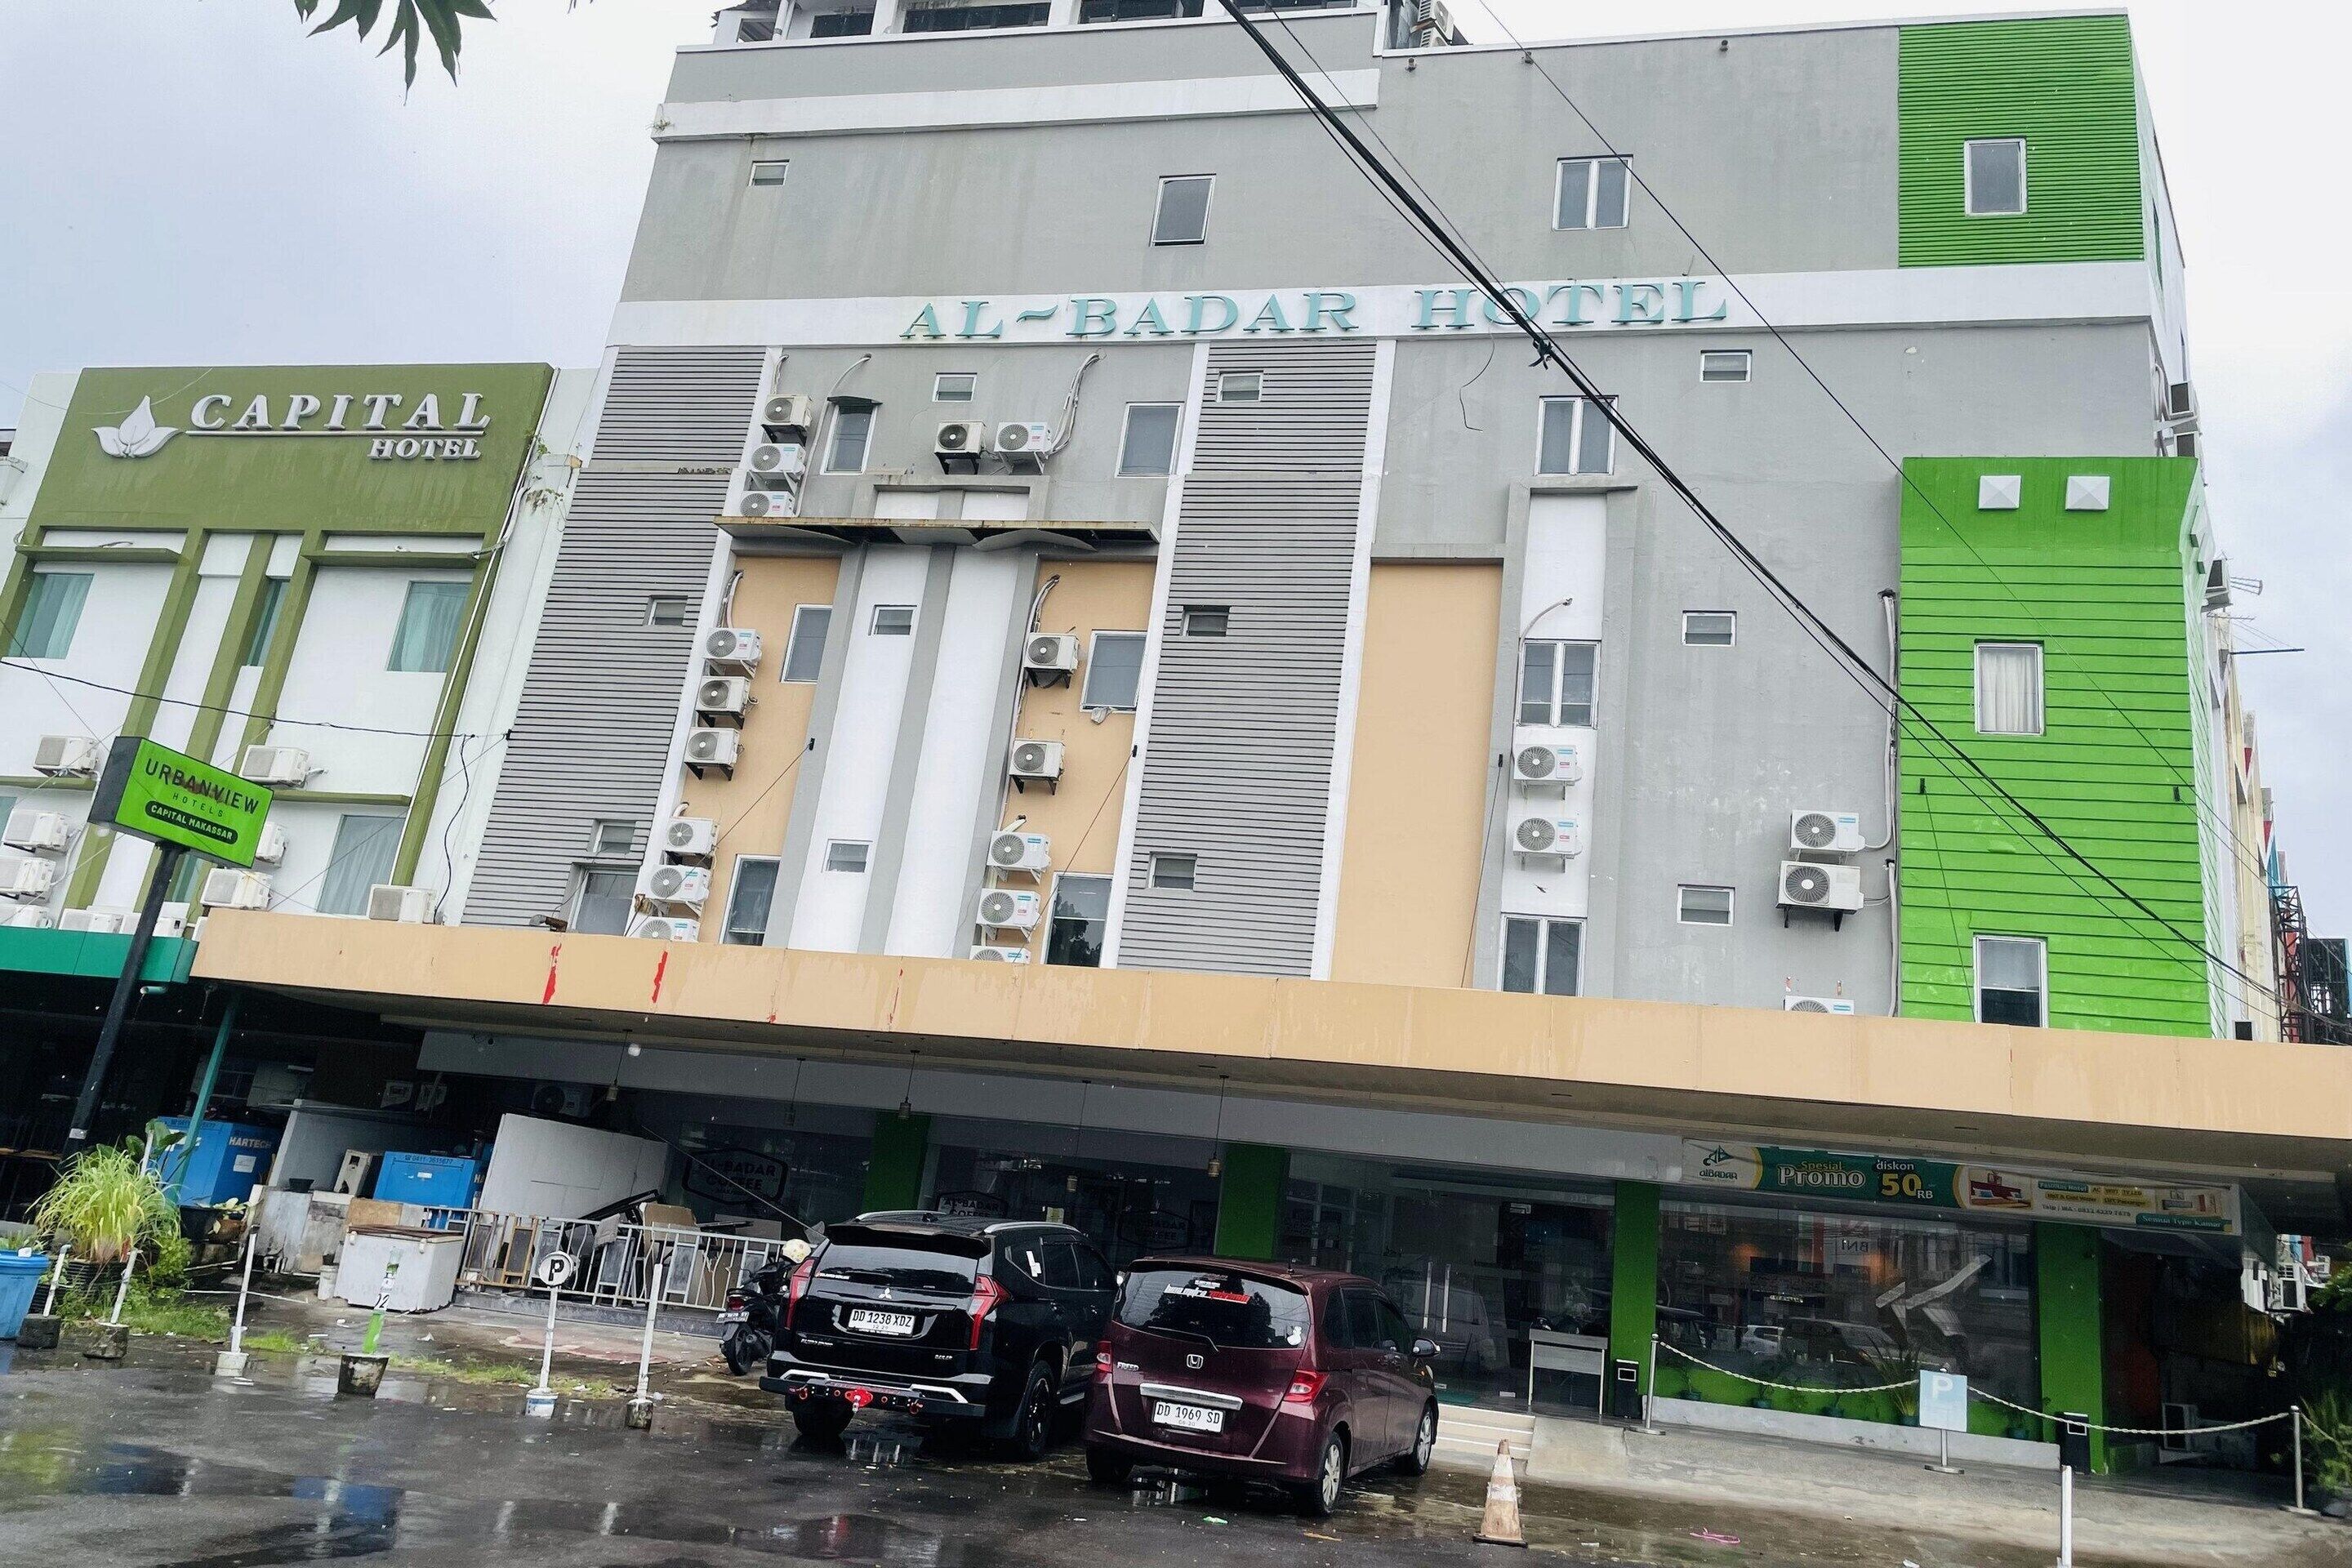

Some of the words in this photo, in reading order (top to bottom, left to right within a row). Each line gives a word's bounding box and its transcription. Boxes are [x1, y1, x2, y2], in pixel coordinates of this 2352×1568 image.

[1410, 281, 1727, 330] HOTEL
[190, 393, 491, 431] CAPITAL
[369, 438, 482, 460] HOTEL
[145, 758, 260, 815] URBANVIEW
[172, 793, 225, 817] HOTELS
[150, 804, 188, 825] CAPITAL
[188, 815, 234, 841] MAKASSAR
[1777, 1165, 1866, 1187] Promo
[1801, 1160, 1842, 1173] Spesial
[1876, 1160, 1915, 1171] diskon
[1881, 1174, 1922, 1196] 50
[1917, 1189, 1934, 1200] RB
[548, 1258, 565, 1281] P
[853, 1310, 866, 1321] DD
[866, 1312, 892, 1325] 1238
[893, 1315, 912, 1328] XDZ
[1931, 1374, 1953, 1400] P
[1156, 1404, 1170, 1416] DD
[1175, 1406, 1201, 1421] 1969
[1206, 1411, 1220, 1424] SD
